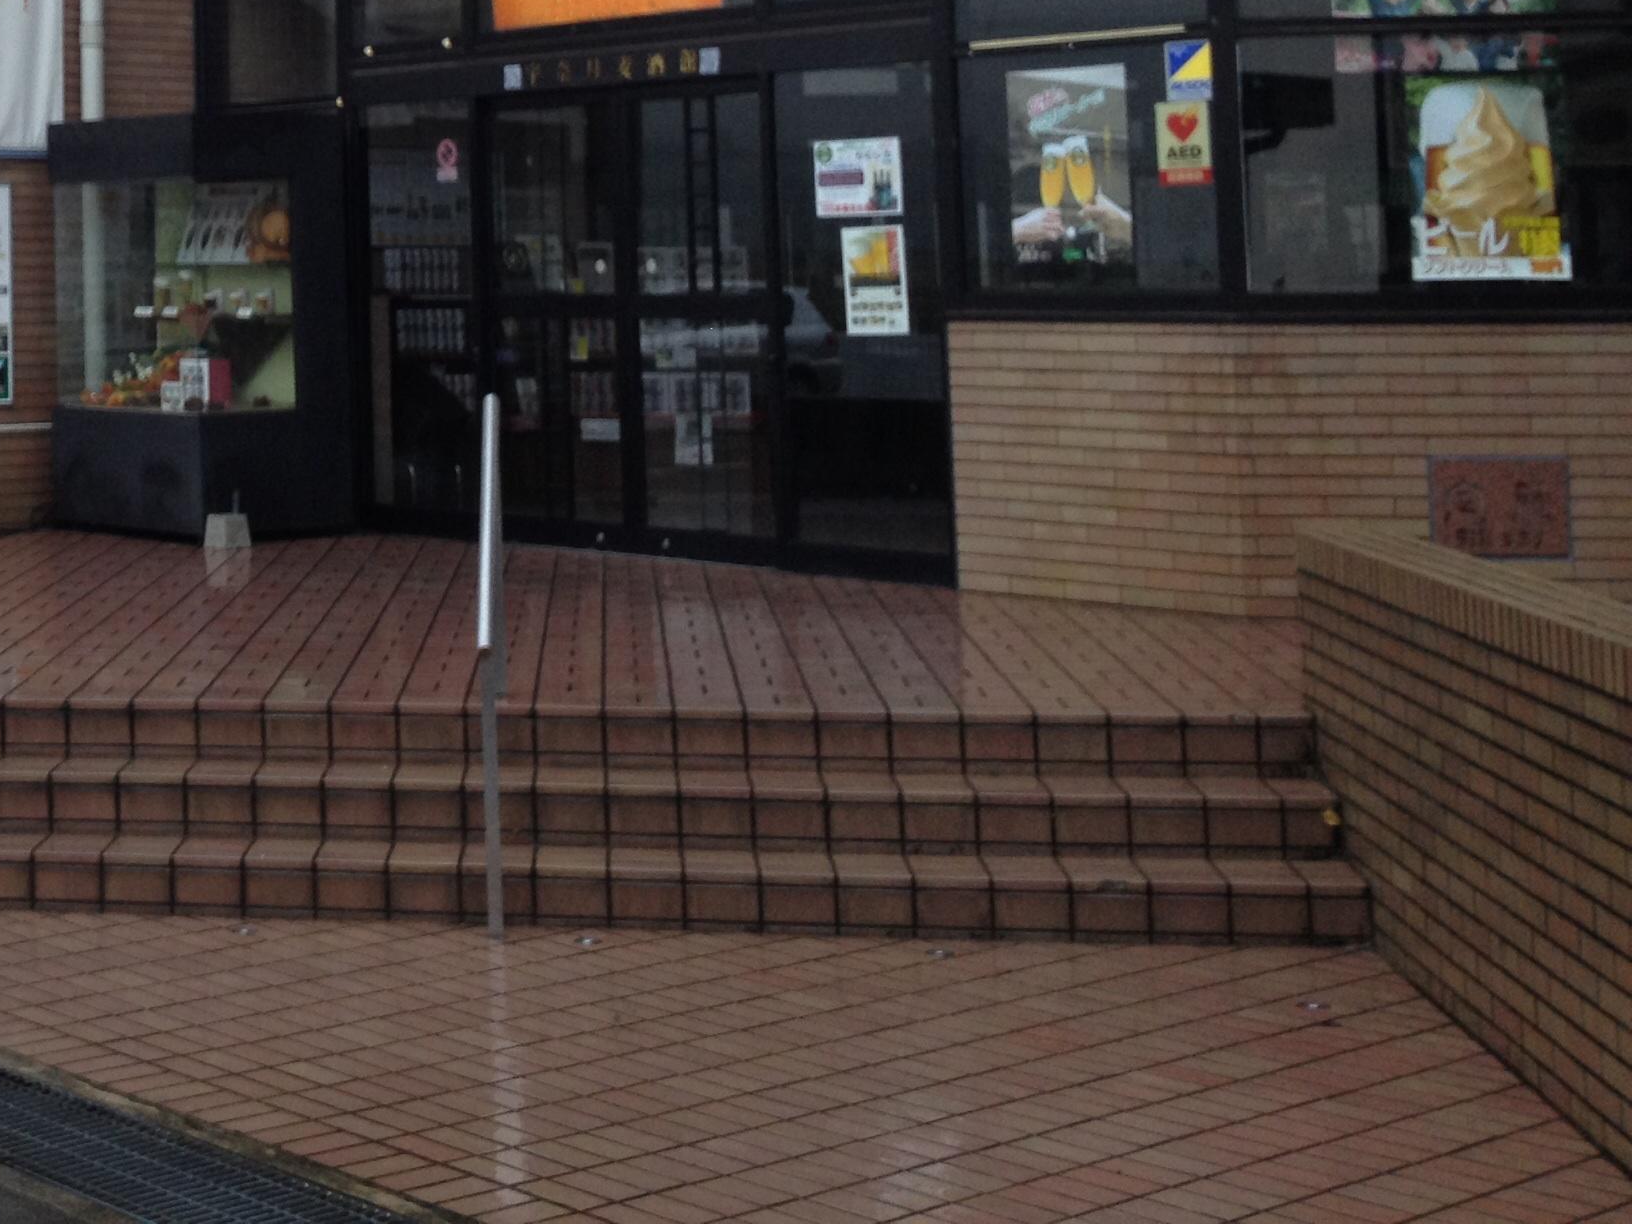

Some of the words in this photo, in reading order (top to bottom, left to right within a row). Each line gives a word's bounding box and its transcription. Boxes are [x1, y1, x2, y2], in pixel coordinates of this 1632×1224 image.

[1167, 144, 1203, 159] AED
[1410, 215, 1510, 257] ビール
